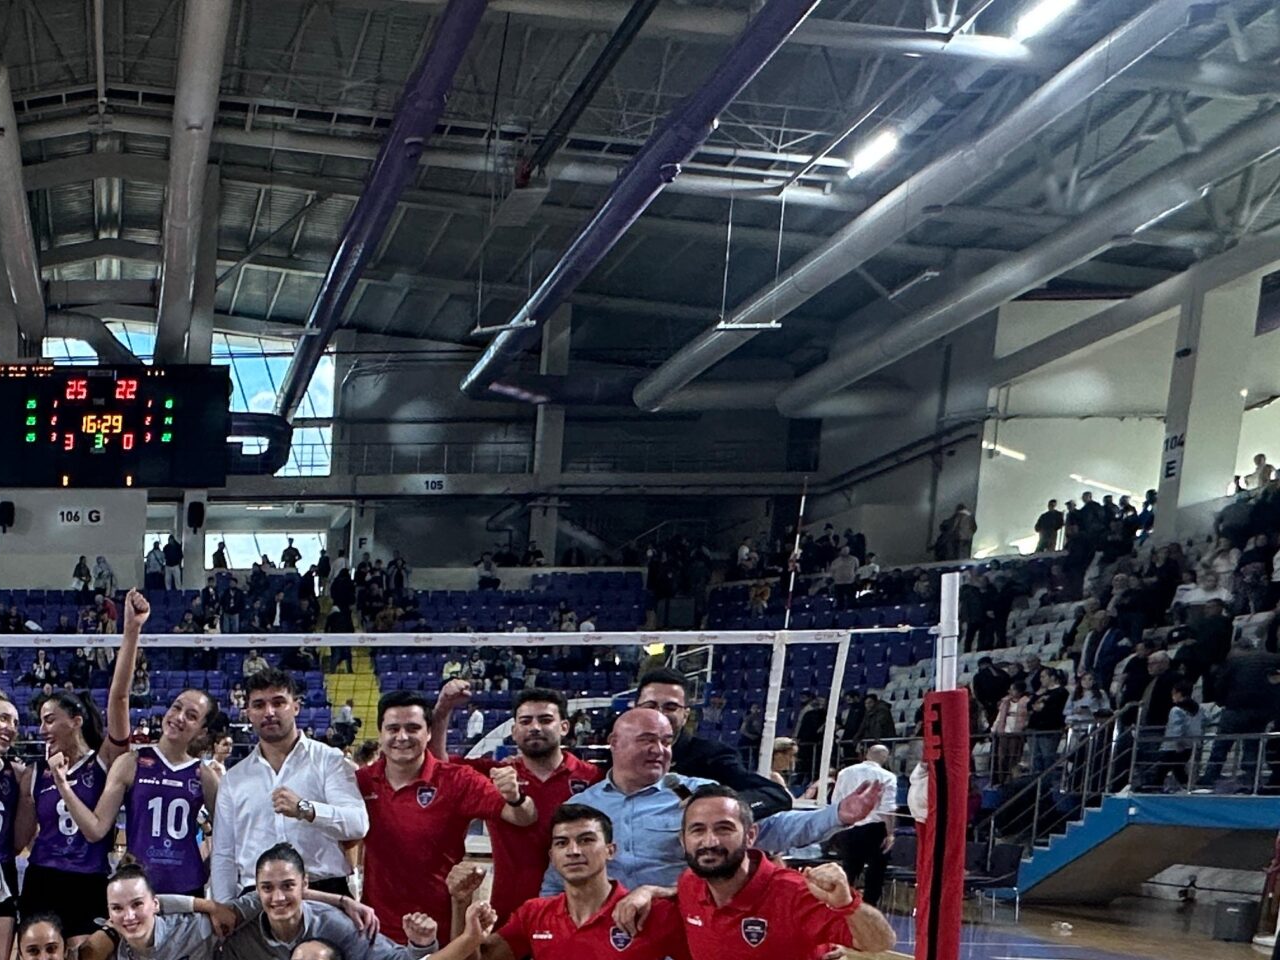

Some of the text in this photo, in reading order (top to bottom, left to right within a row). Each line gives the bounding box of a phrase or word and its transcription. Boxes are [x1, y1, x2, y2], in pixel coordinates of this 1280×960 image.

[66, 381, 87, 399] 25
[116, 380, 137, 399] 22
[82, 415, 123, 433] 16:29
[64, 434, 74, 450] 3
[94, 433, 103, 449] 3
[123, 434, 133, 450] 0
[1164, 432, 1185, 452] 104
[1165, 460, 1177, 479] E
[424, 480, 444, 490] 105
[59, 509, 101, 523] 106 G
[358, 538, 368, 549] F
[56, 799, 78, 836] 8
[148, 796, 190, 840] 10
